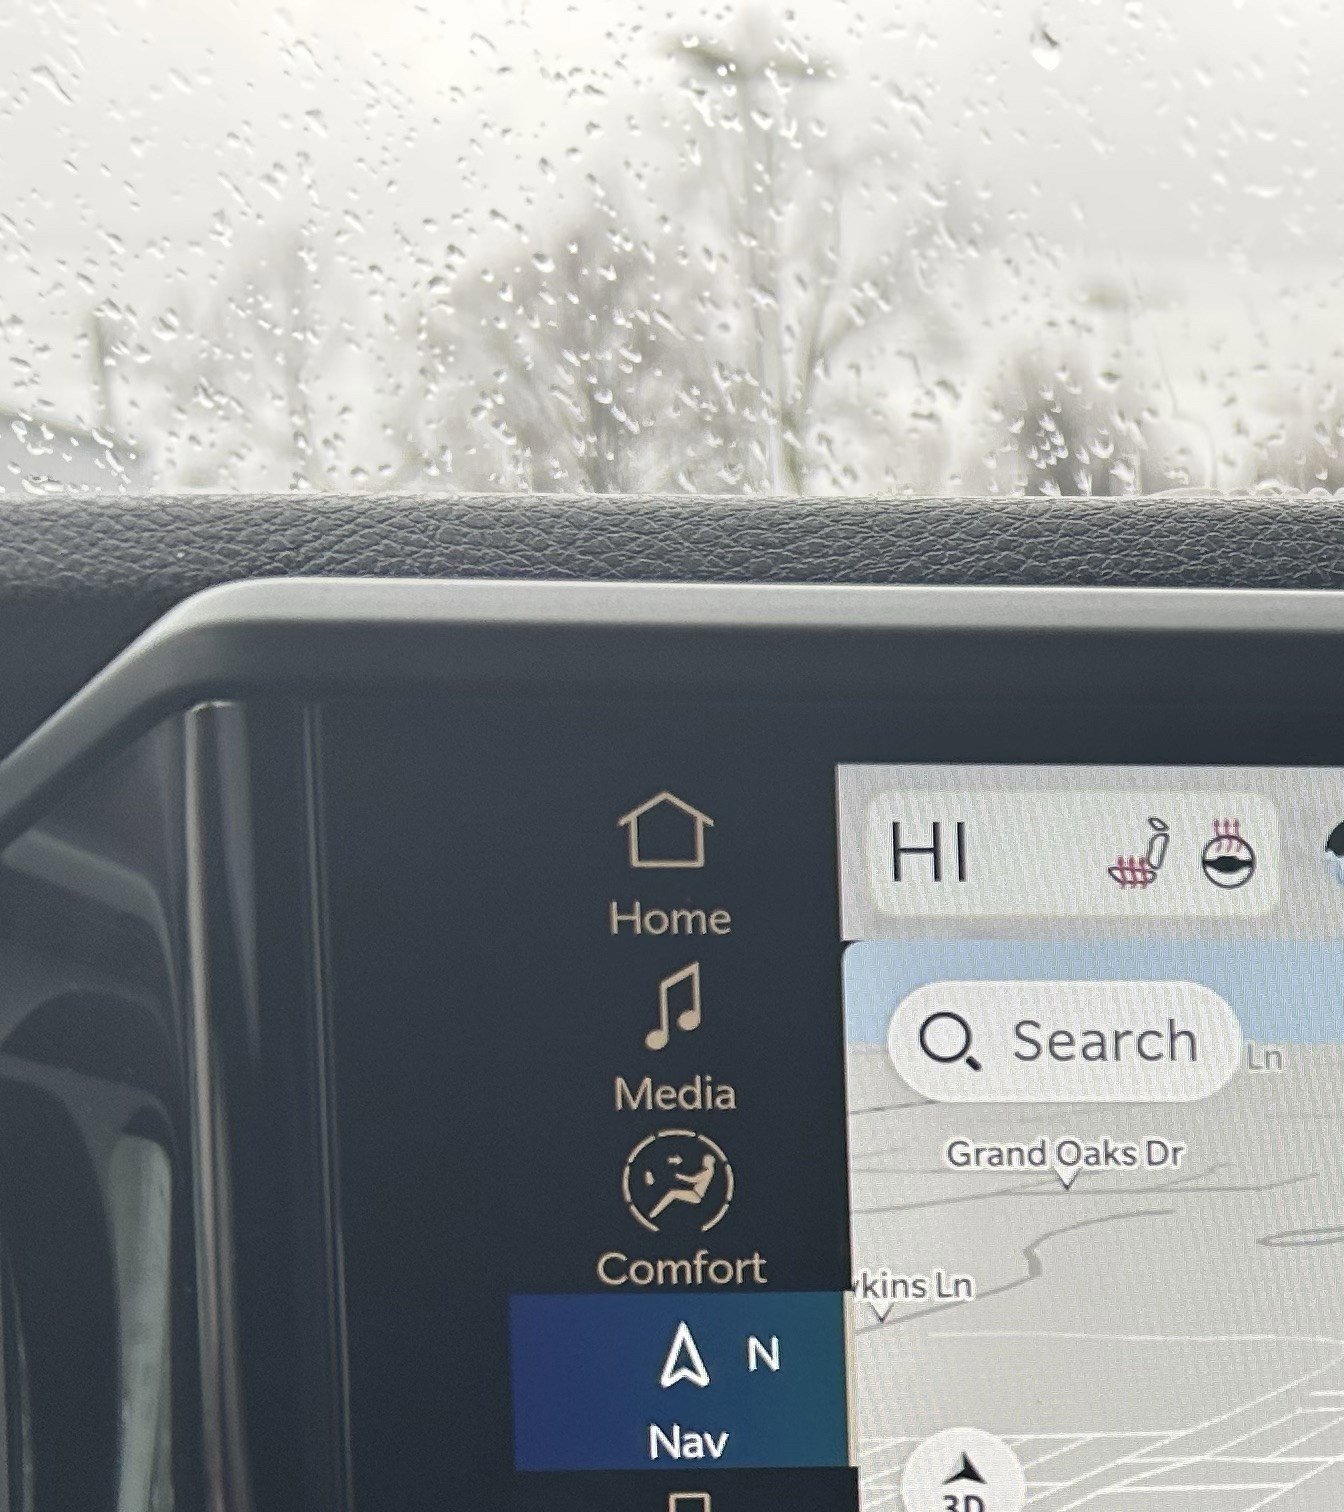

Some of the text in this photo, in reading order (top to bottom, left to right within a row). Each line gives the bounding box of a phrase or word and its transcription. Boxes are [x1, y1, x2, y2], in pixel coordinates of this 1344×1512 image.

[891, 821, 966, 882] HI
[610, 900, 732, 935] Home
[1014, 1018, 1197, 1062] Search
[1247, 1043, 1282, 1070] Ln
[615, 1074, 736, 1111] Media
[947, 1139, 1183, 1167] Grand Oaks Dr
[596, 1249, 768, 1286] Comfort
[853, 1271, 975, 1300] kins Ln
[748, 1336, 780, 1372] N
[649, 1424, 729, 1460] Nav
